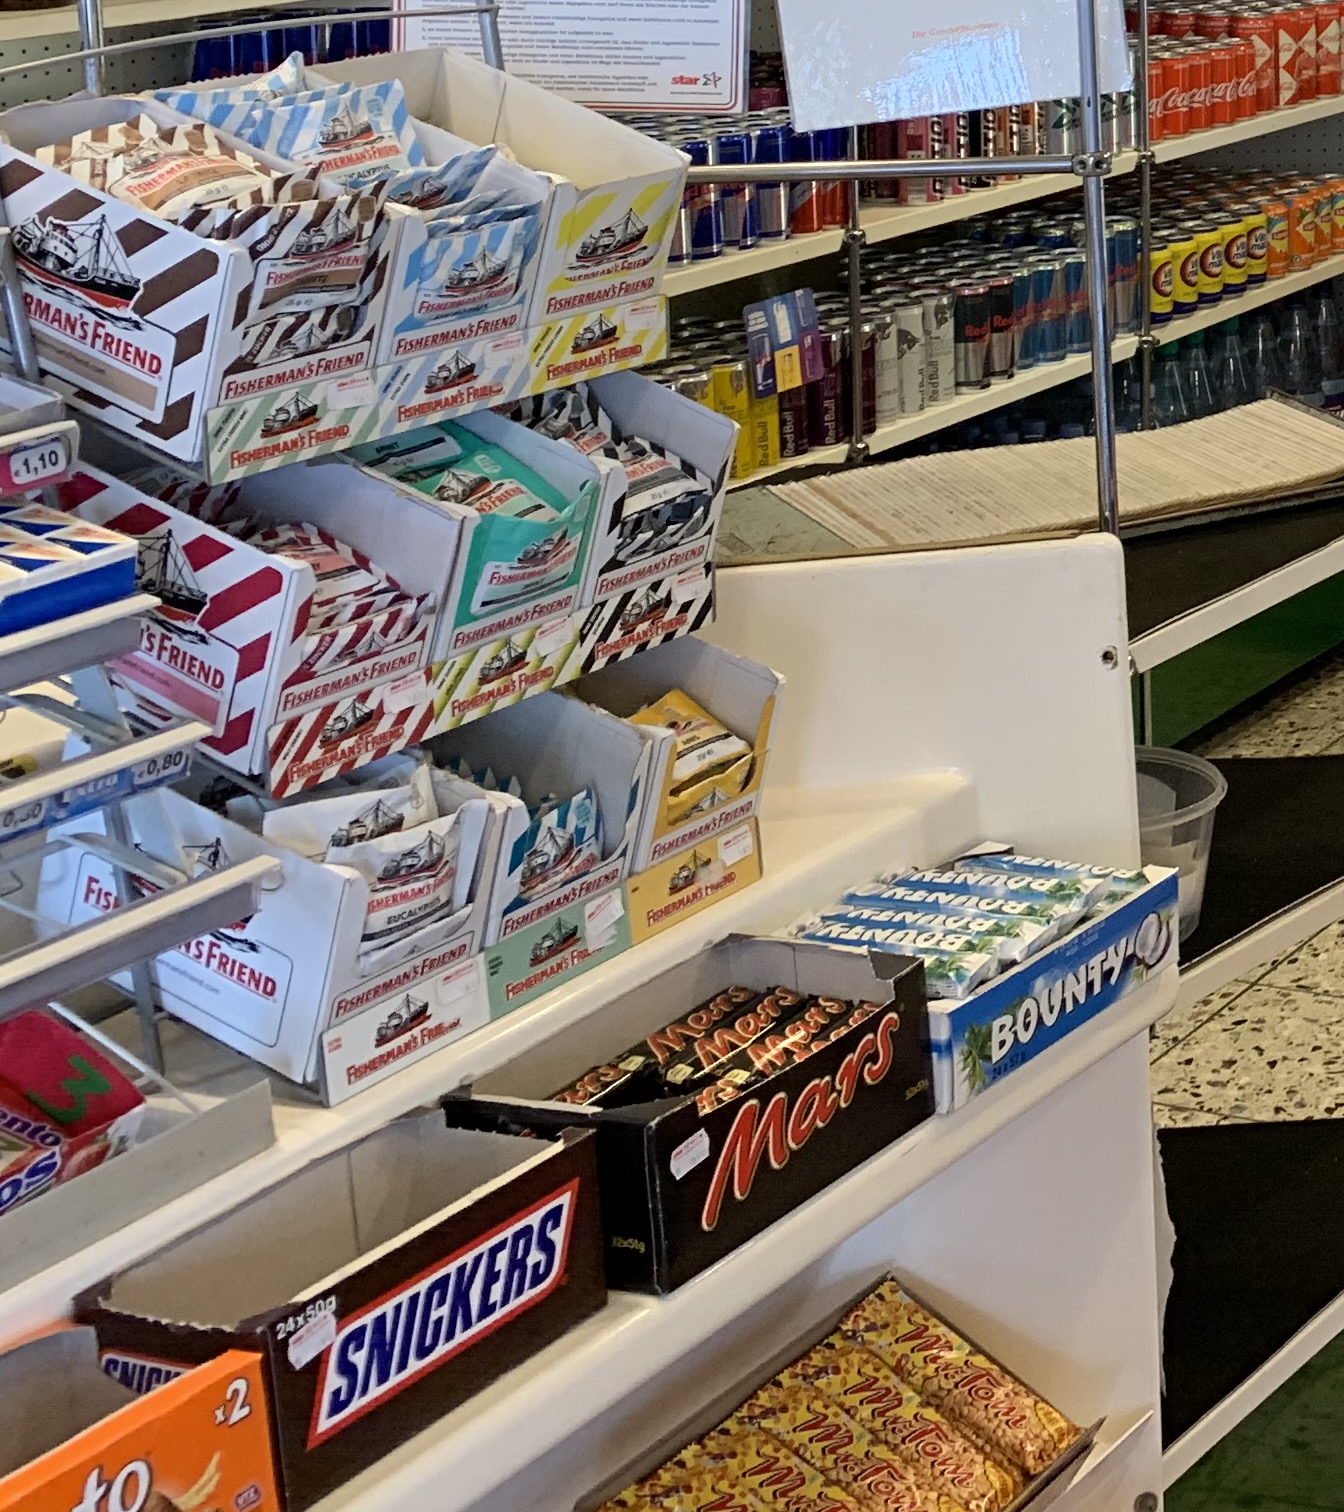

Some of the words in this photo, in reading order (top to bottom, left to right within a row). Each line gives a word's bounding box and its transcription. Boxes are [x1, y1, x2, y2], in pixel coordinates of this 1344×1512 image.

[671, 74, 701, 87] star
[546, 286, 617, 315] FISHERMAN'S
[617, 276, 655, 296] FRIEND
[90, 324, 163, 378] FRIEND
[396, 324, 475, 357] FISHERMAN'S
[474, 314, 518, 337] FRIEND
[223, 362, 315, 400] FISHERMAN'S
[315, 351, 365, 377] FRIEND
[230, 434, 307, 469] FISHERMAN'S
[598, 561, 668, 596] FISHERMAN'S
[667, 544, 706, 568] FRIEND
[454, 609, 532, 650] FISHERMAN'S
[158, 632, 226, 691] FRIEND
[282, 670, 371, 711] FISHERMAN'S
[369, 651, 418, 679] FRIEND
[650, 818, 717, 862] FISHERMAN'S
[717, 799, 753, 827] FRIEND
[503, 889, 577, 937] FISHERMAN'S
[577, 867, 619, 900] FRIEND
[205, 940, 278, 1003] FRIEND
[335, 966, 420, 1018] FISHERMAN'S
[420, 943, 468, 978] FRIEND
[991, 935, 1130, 1065] BOUNTY
[646, 985, 754, 1065] Mars
[694, 985, 801, 1072] Mars
[701, 1011, 900, 1232] Mars
[325, 1203, 565, 1420] SNICKERS
